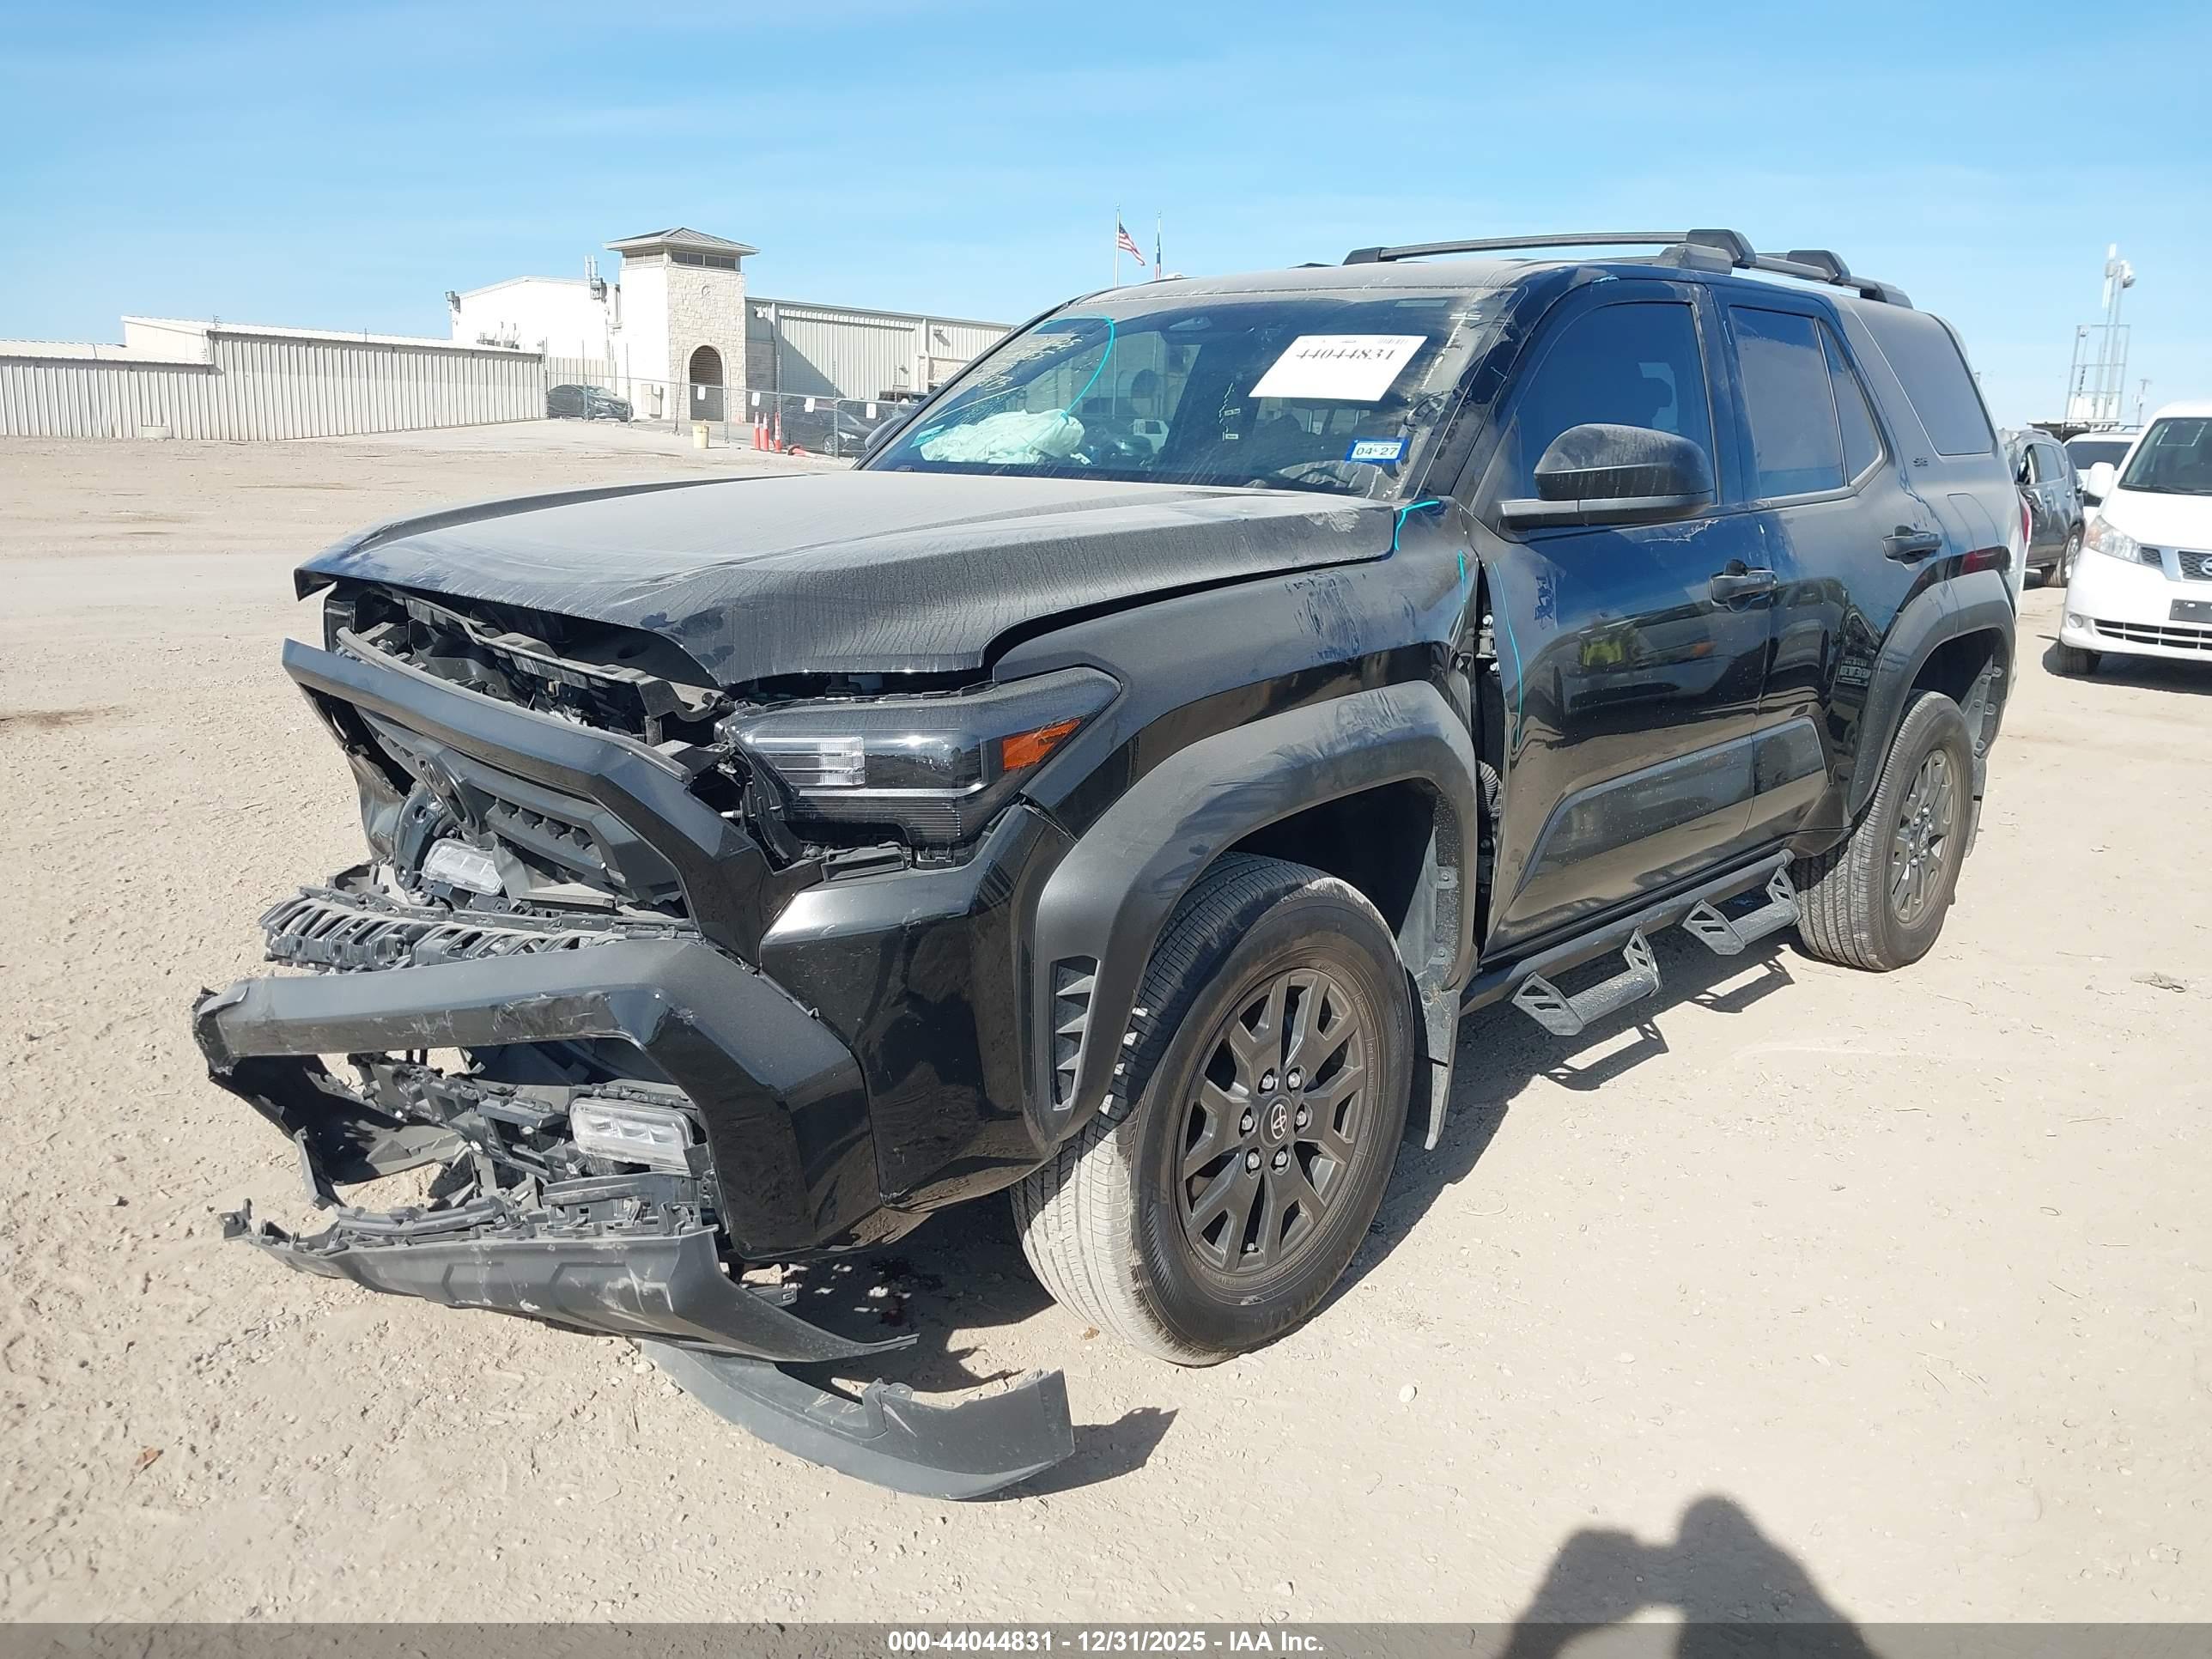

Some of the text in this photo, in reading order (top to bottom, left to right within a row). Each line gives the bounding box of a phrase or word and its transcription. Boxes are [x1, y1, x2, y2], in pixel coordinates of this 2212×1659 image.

[1296, 349, 1395, 361] 44044831
[1356, 447, 1399, 456] 04 27
